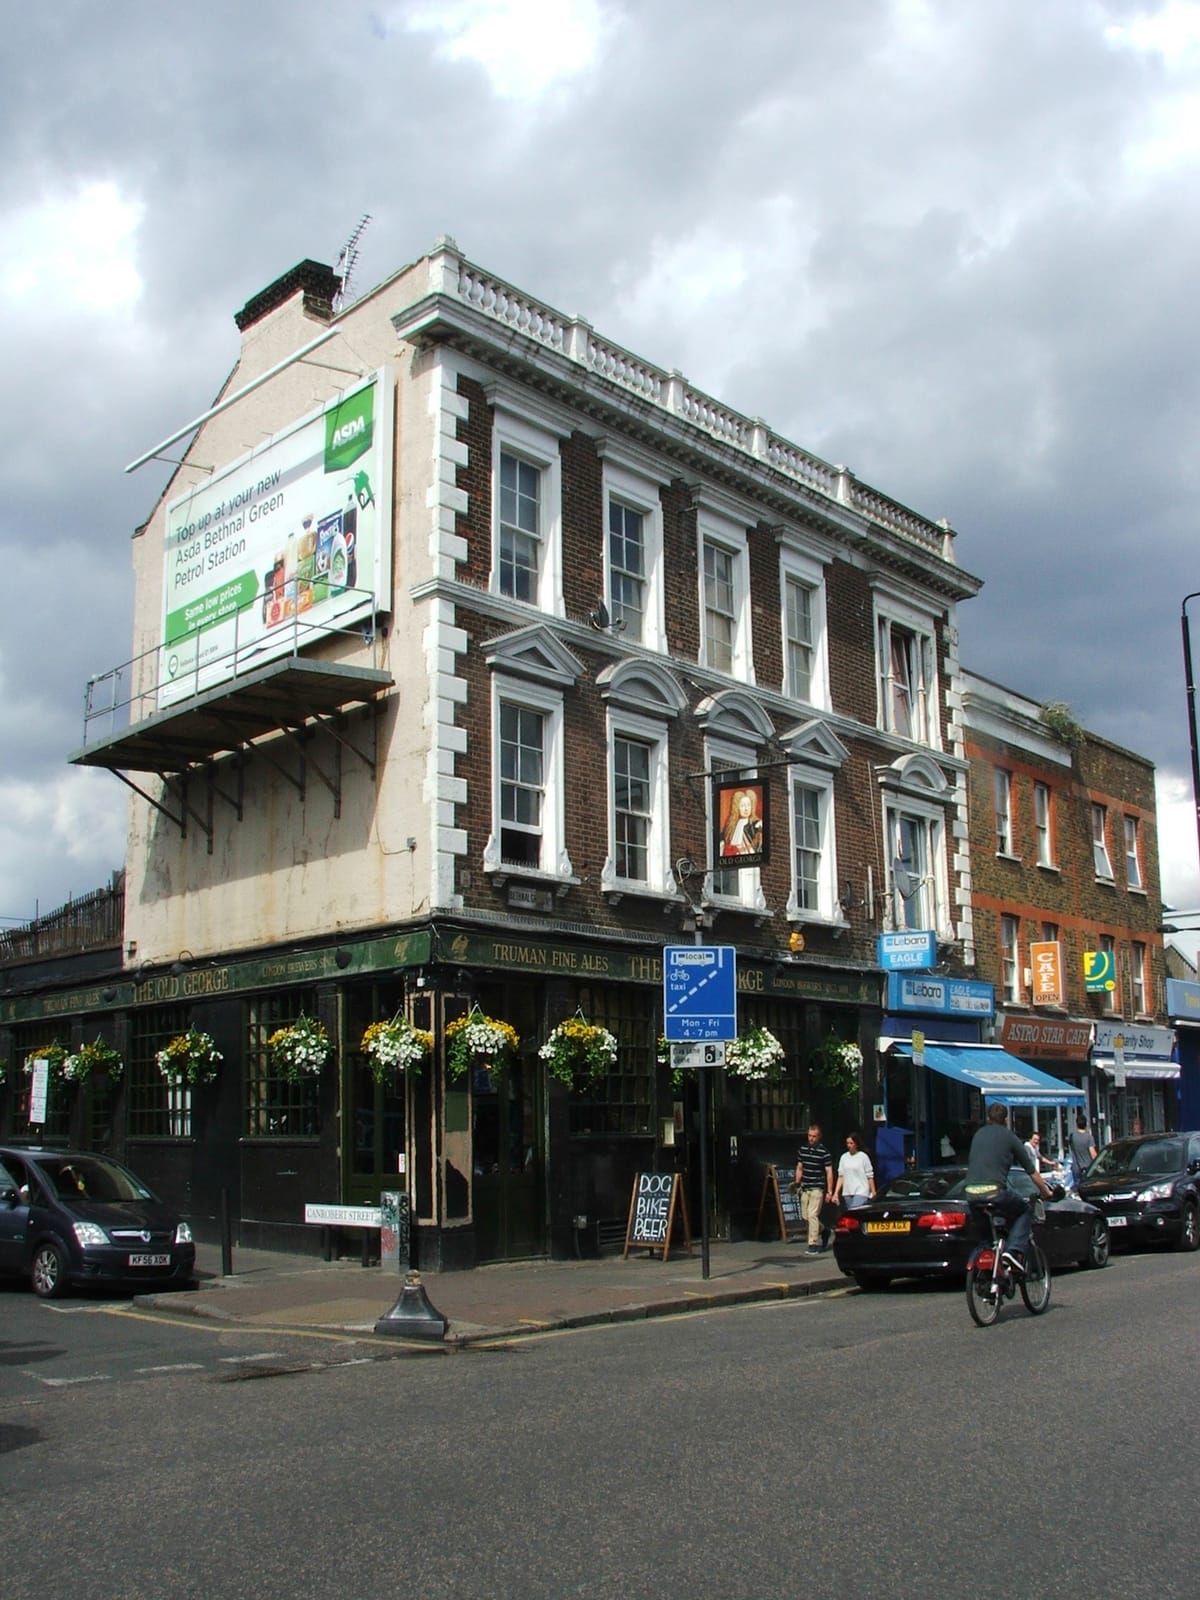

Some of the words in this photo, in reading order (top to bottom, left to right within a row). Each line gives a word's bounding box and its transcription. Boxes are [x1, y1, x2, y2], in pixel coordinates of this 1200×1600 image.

[332, 416, 365, 446] ASDA
[175, 523, 196, 543] Top
[198, 512, 212, 532] up
[214, 501, 225, 521] at
[228, 486, 255, 516] your
[257, 469, 281, 496] new
[175, 539, 201, 567] Asda
[204, 511, 245, 550] Bethnal
[249, 492, 284, 523] Green
[174, 556, 205, 590] Petrol
[208, 538, 246, 571] Station
[184, 603, 205, 618] Same
[205, 595, 220, 610] low
[219, 583, 242, 604] prices
[492, 943, 546, 965] TRUMAN
[552, 951, 577, 968] FINE
[581, 955, 609, 972] ALES
[628, 956, 661, 981] THE
[685, 952, 706, 960] local
[890, 952, 924, 963] EAGLE
[1037, 952, 1055, 992] CAFE
[131, 981, 154, 1003] THE
[158, 977, 179, 999] OLD
[183, 968, 229, 995] GEORGE
[670, 983, 686, 991] taxi
[951, 984, 970, 994] EAGLE
[1036, 993, 1059, 1002] OPEN
[681, 1019, 701, 1027] Mon
[708, 1019, 720, 1027] Fri
[683, 1029, 690, 1037] 4
[697, 1029, 703, 1037] 7
[704, 1030, 718, 1038] pm
[1007, 1023, 1040, 1042] ASTRO
[1041, 1026, 1065, 1045] STAR
[1066, 1028, 1090, 1046] CAFE
[1138, 1034, 1154, 1049] Shop
[639, 1174, 672, 1193] DOG
[637, 1196, 669, 1216] BIKE
[348, 1211, 374, 1221] STREET
[634, 1218, 668, 1238] BEER
[132, 1256, 152, 1265] KF56
